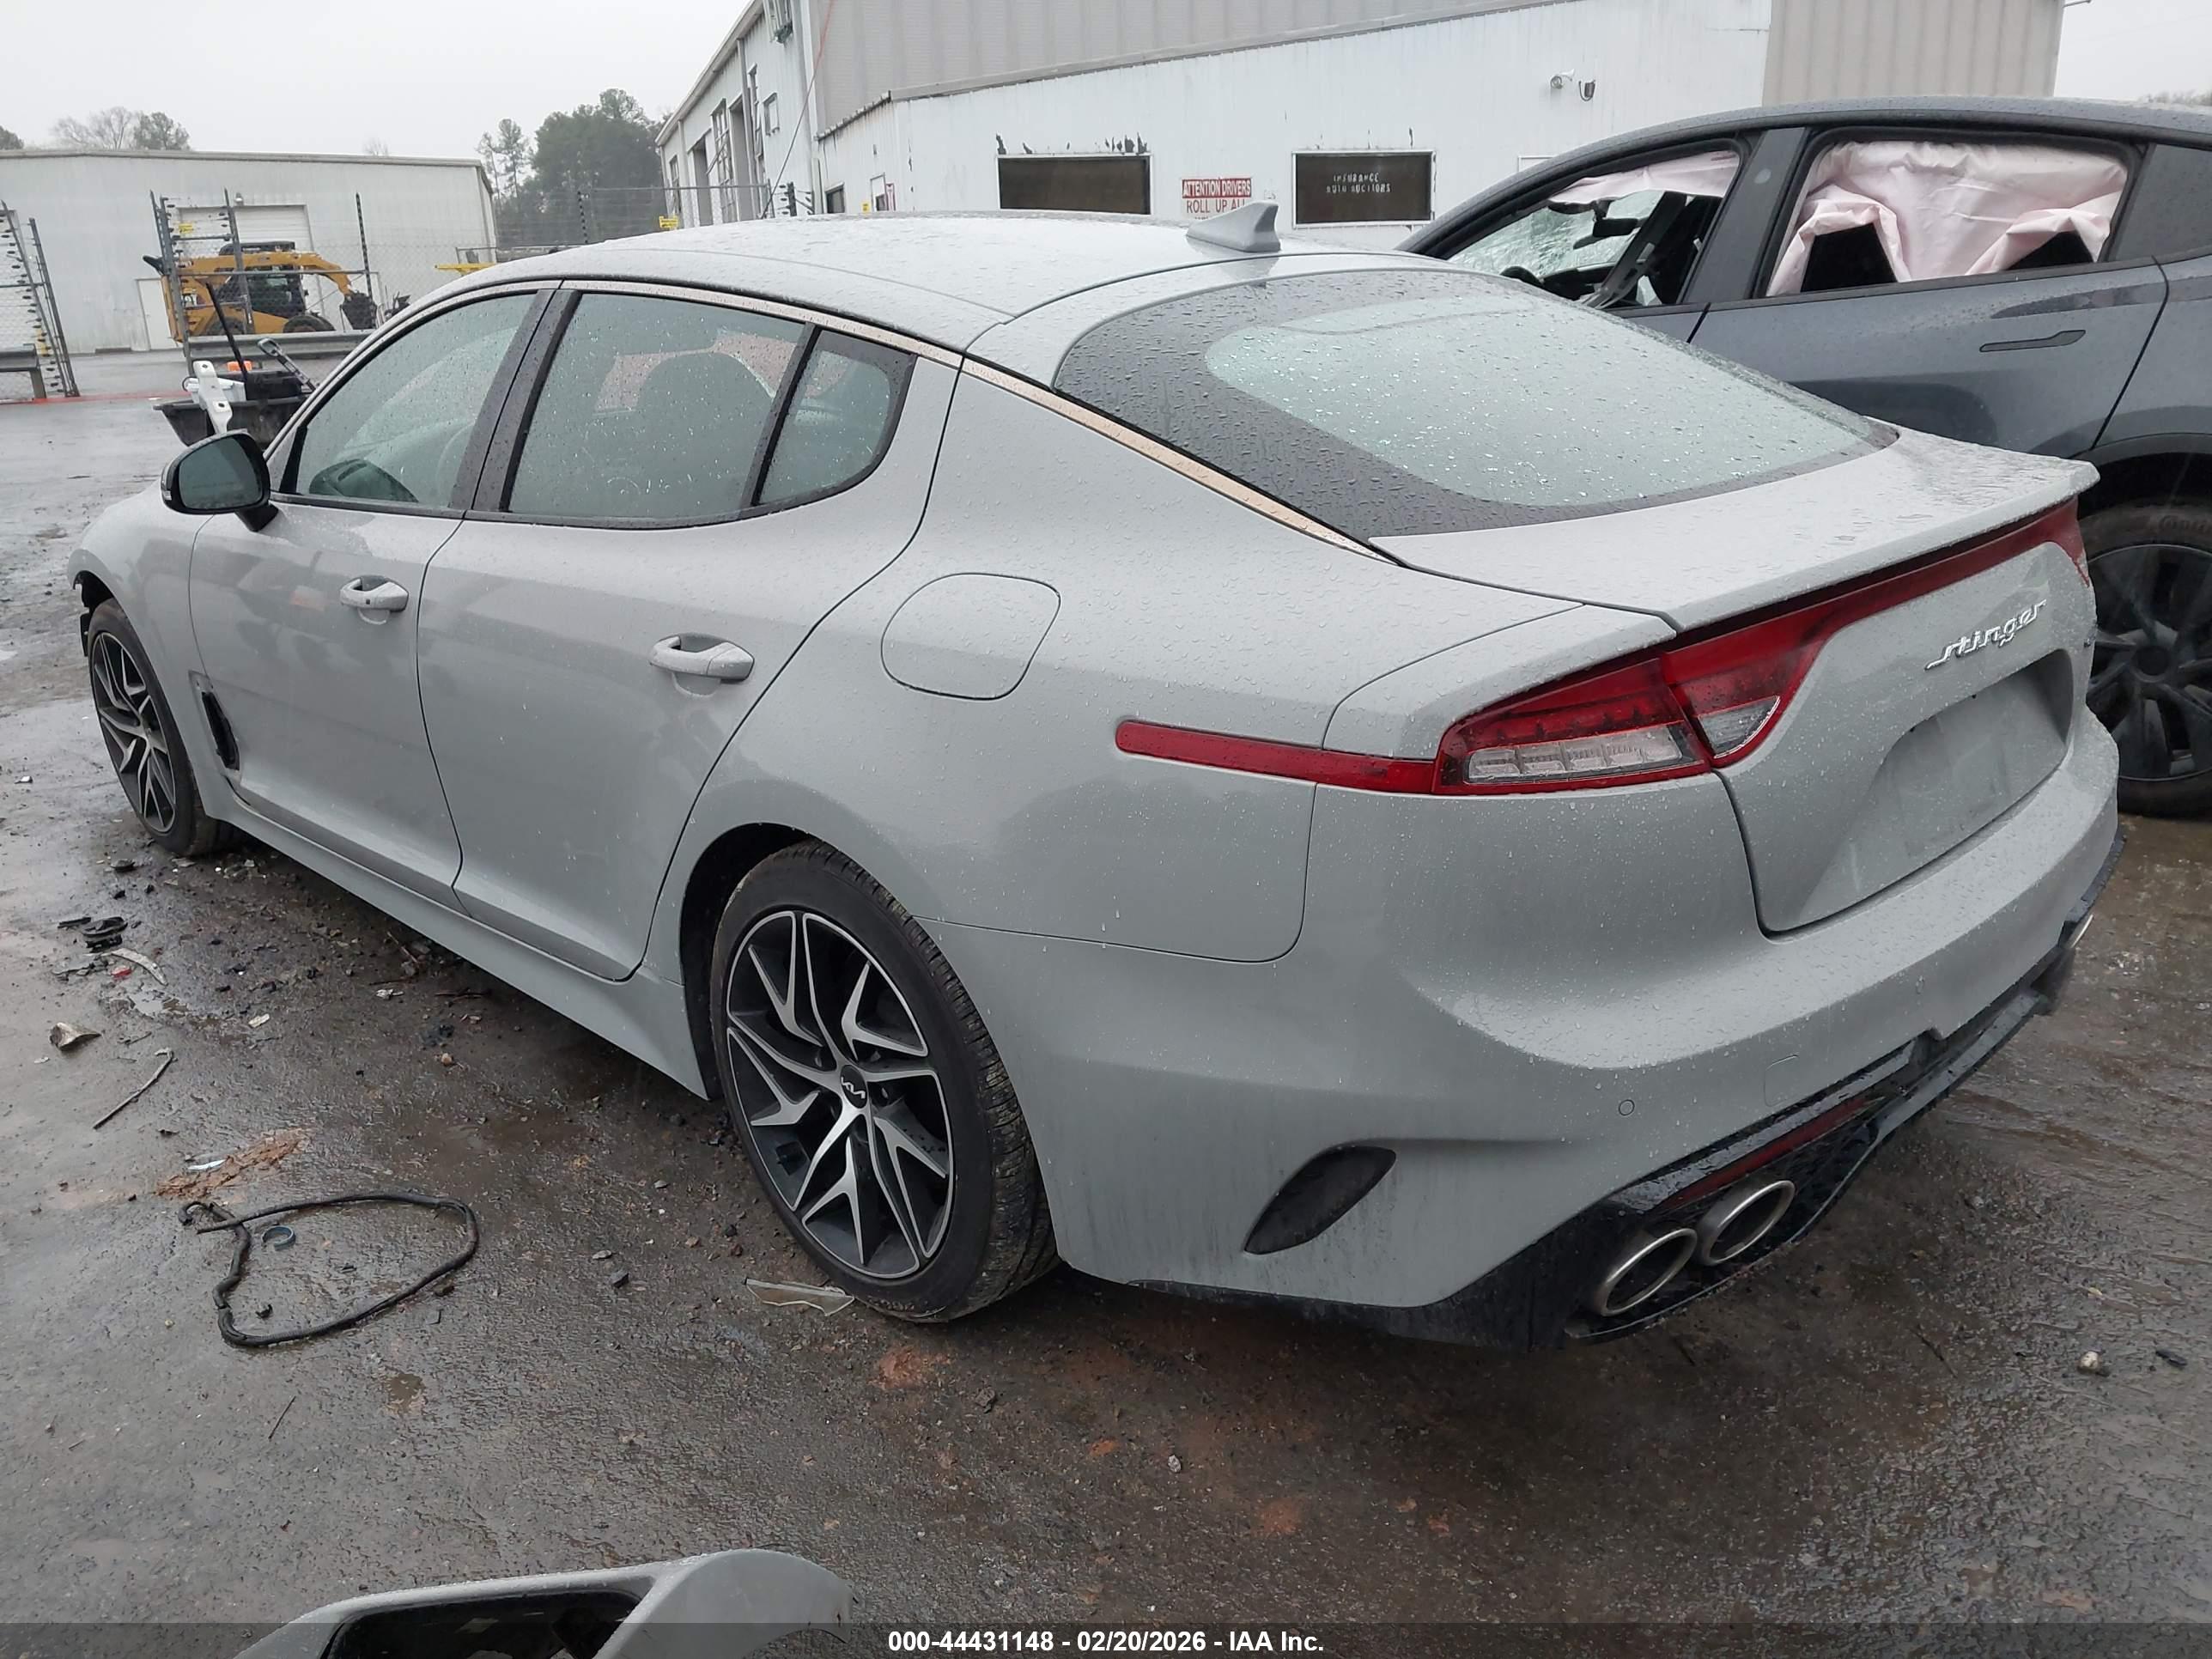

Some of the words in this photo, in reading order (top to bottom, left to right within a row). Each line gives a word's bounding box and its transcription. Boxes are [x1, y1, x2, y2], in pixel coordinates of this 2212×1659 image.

[1182, 179, 1219, 197] ATTENTION
[1221, 179, 1251, 196] DRIVERS
[1186, 199, 1210, 213] ROLL
[1215, 199, 1227, 213] UP
[1923, 599, 2046, 670] stinger
